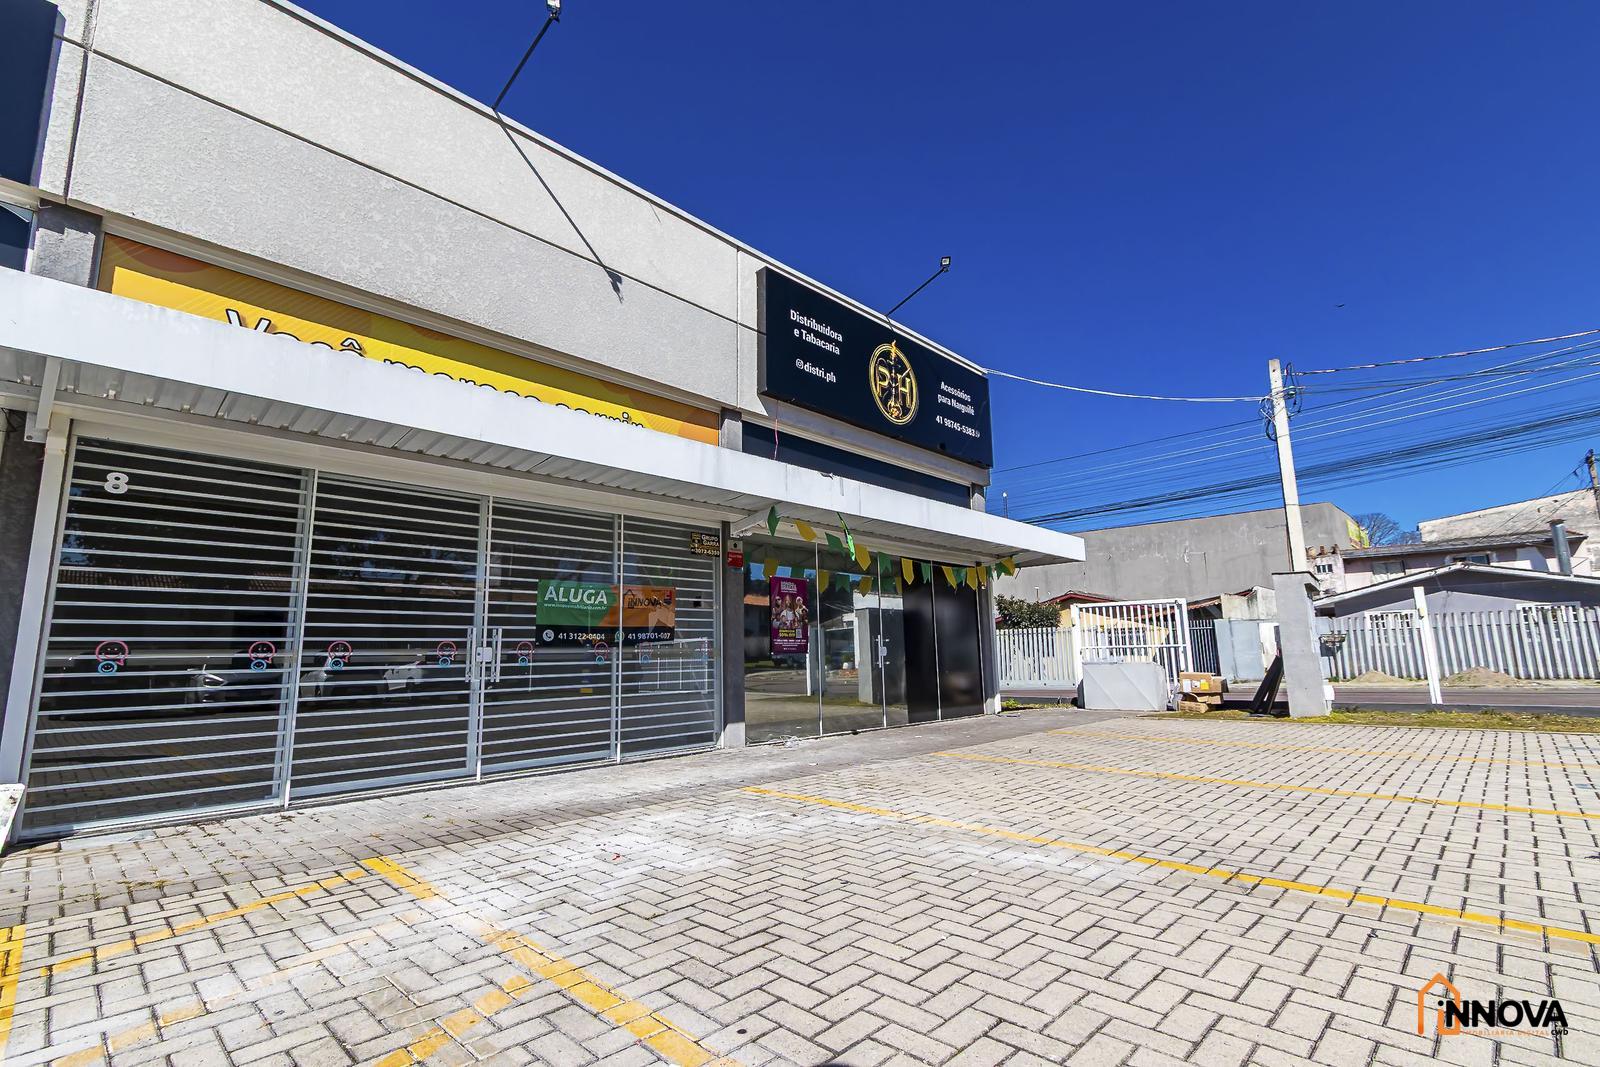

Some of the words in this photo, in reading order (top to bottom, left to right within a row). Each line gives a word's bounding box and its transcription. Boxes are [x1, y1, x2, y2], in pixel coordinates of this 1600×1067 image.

[790, 309, 842, 342] Distribuidora
[793, 328, 800, 338] e
[801, 329, 840, 355] Tabacaria
[941, 381, 971, 402] Acessórios
[937, 394, 951, 405] para
[951, 399, 975, 416] Narguilé
[936, 415, 943, 424] 41
[104, 472, 129, 494] 8
[544, 586, 608, 605] ALUGA
[558, 632, 567, 640] 41
[569, 632, 606, 640] 3122-0404
[628, 632, 636, 640] 41
